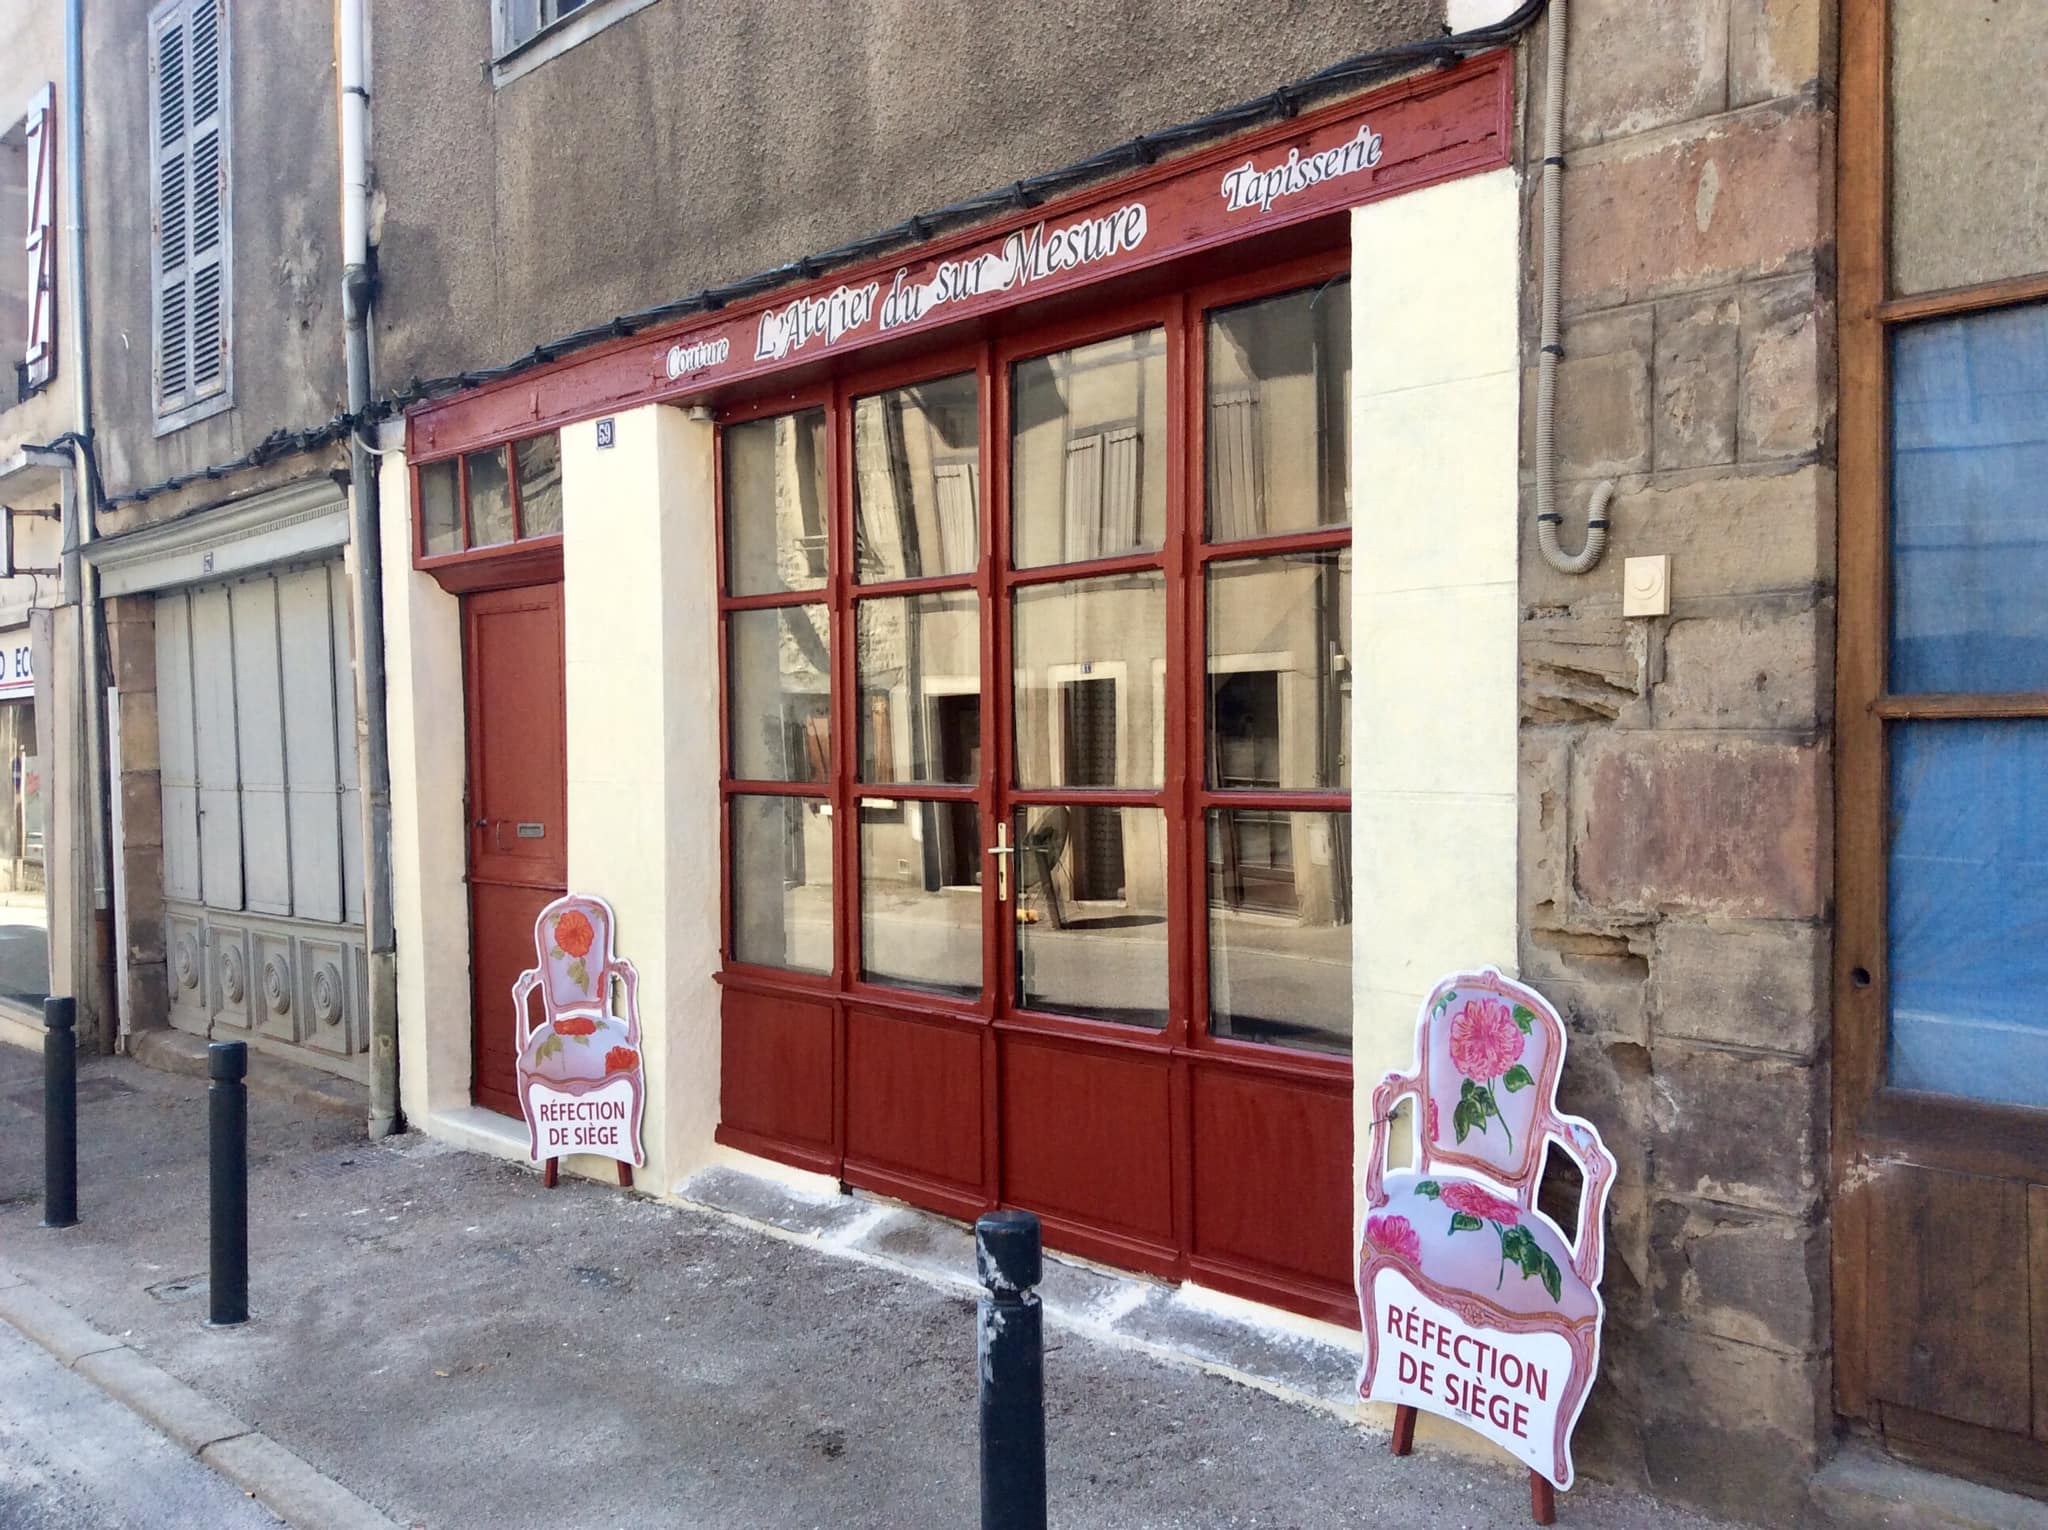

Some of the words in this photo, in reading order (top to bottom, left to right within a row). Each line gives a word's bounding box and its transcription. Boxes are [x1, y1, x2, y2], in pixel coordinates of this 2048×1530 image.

[1223, 126, 1383, 213] Tapisserie
[883, 270, 922, 328] du
[936, 255, 988, 301] sur
[1003, 206, 1141, 286] Mesure
[668, 340, 728, 378] Couture
[599, 423, 611, 445] 59
[540, 1099, 625, 1122] RÉFECTION
[549, 1127, 569, 1145] DE
[574, 1122, 618, 1145] SIÈGE
[1387, 1304, 1548, 1401] RÉFECTION
[1399, 1351, 1435, 1395] DE
[1444, 1376, 1530, 1439] SIÈGE
